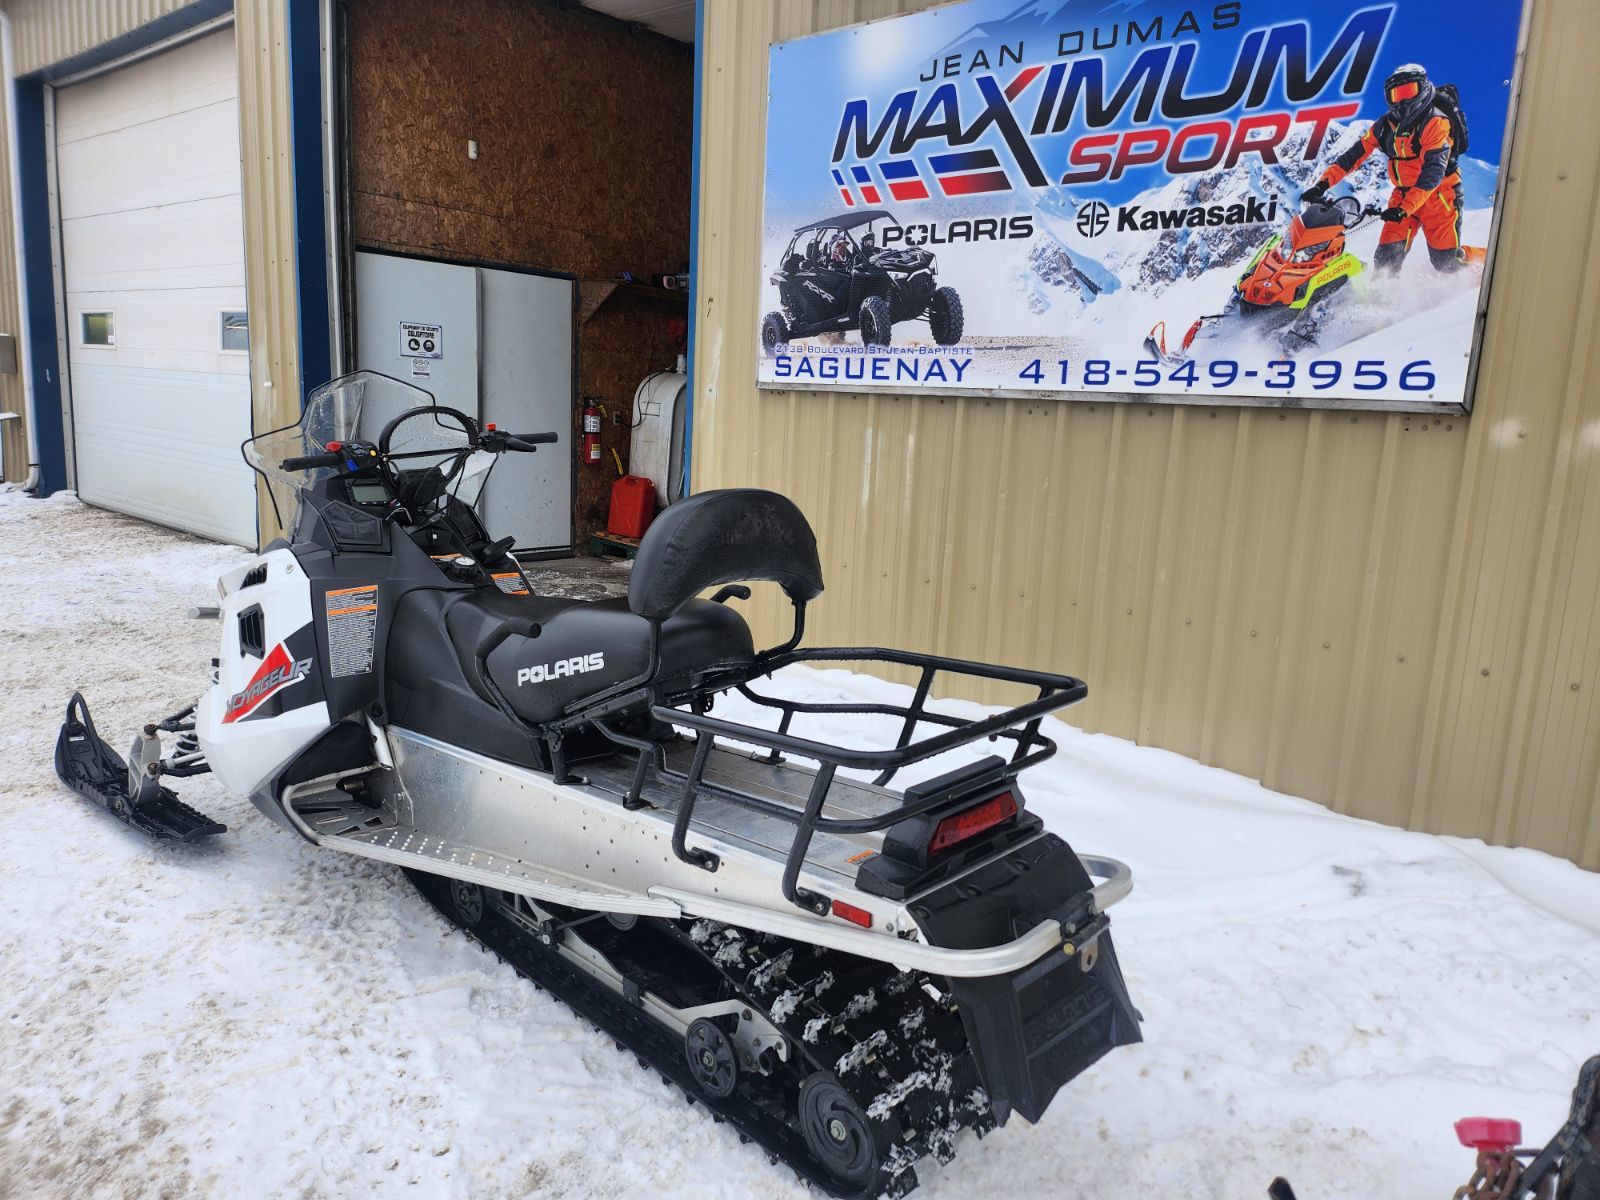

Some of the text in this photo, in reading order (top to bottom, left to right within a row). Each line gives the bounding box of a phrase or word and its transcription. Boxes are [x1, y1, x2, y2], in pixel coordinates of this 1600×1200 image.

[919, 2, 1241, 82] JEAN DUMAS
[832, 4, 1396, 188] MAXIMUM
[1061, 103, 1360, 185] SPORT
[882, 215, 1033, 247] POLARIS
[1116, 194, 1278, 232] Kawasaki
[1316, 260, 1352, 286] POLARIS
[774, 355, 973, 383] SAGUENAY
[1019, 359, 1436, 391] 418-549-3956
[225, 656, 314, 715] VOYAGEUR
[517, 651, 605, 687] POLARIS
